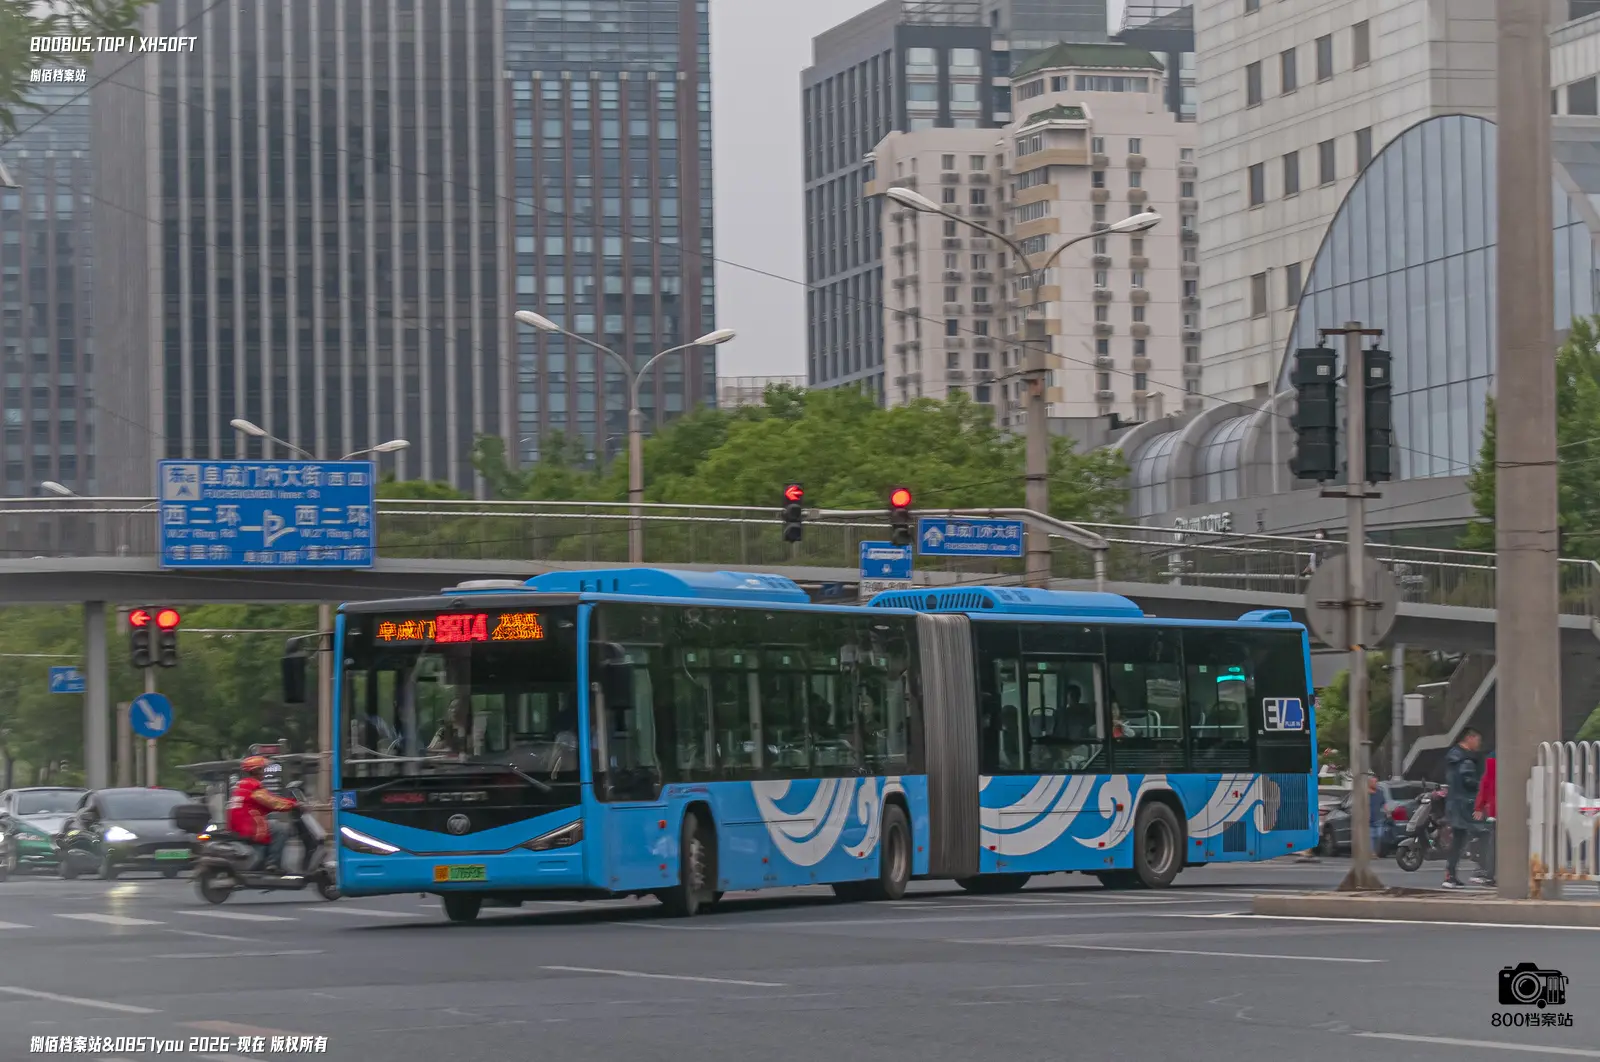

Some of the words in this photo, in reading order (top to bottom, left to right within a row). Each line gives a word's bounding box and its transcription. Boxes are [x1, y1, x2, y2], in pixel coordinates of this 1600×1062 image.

[201, 465, 323, 487] 阜成门内大街
[163, 504, 241, 526] 西二环
[294, 504, 369, 526] 西二环
[376, 619, 436, 641] 阜成门
